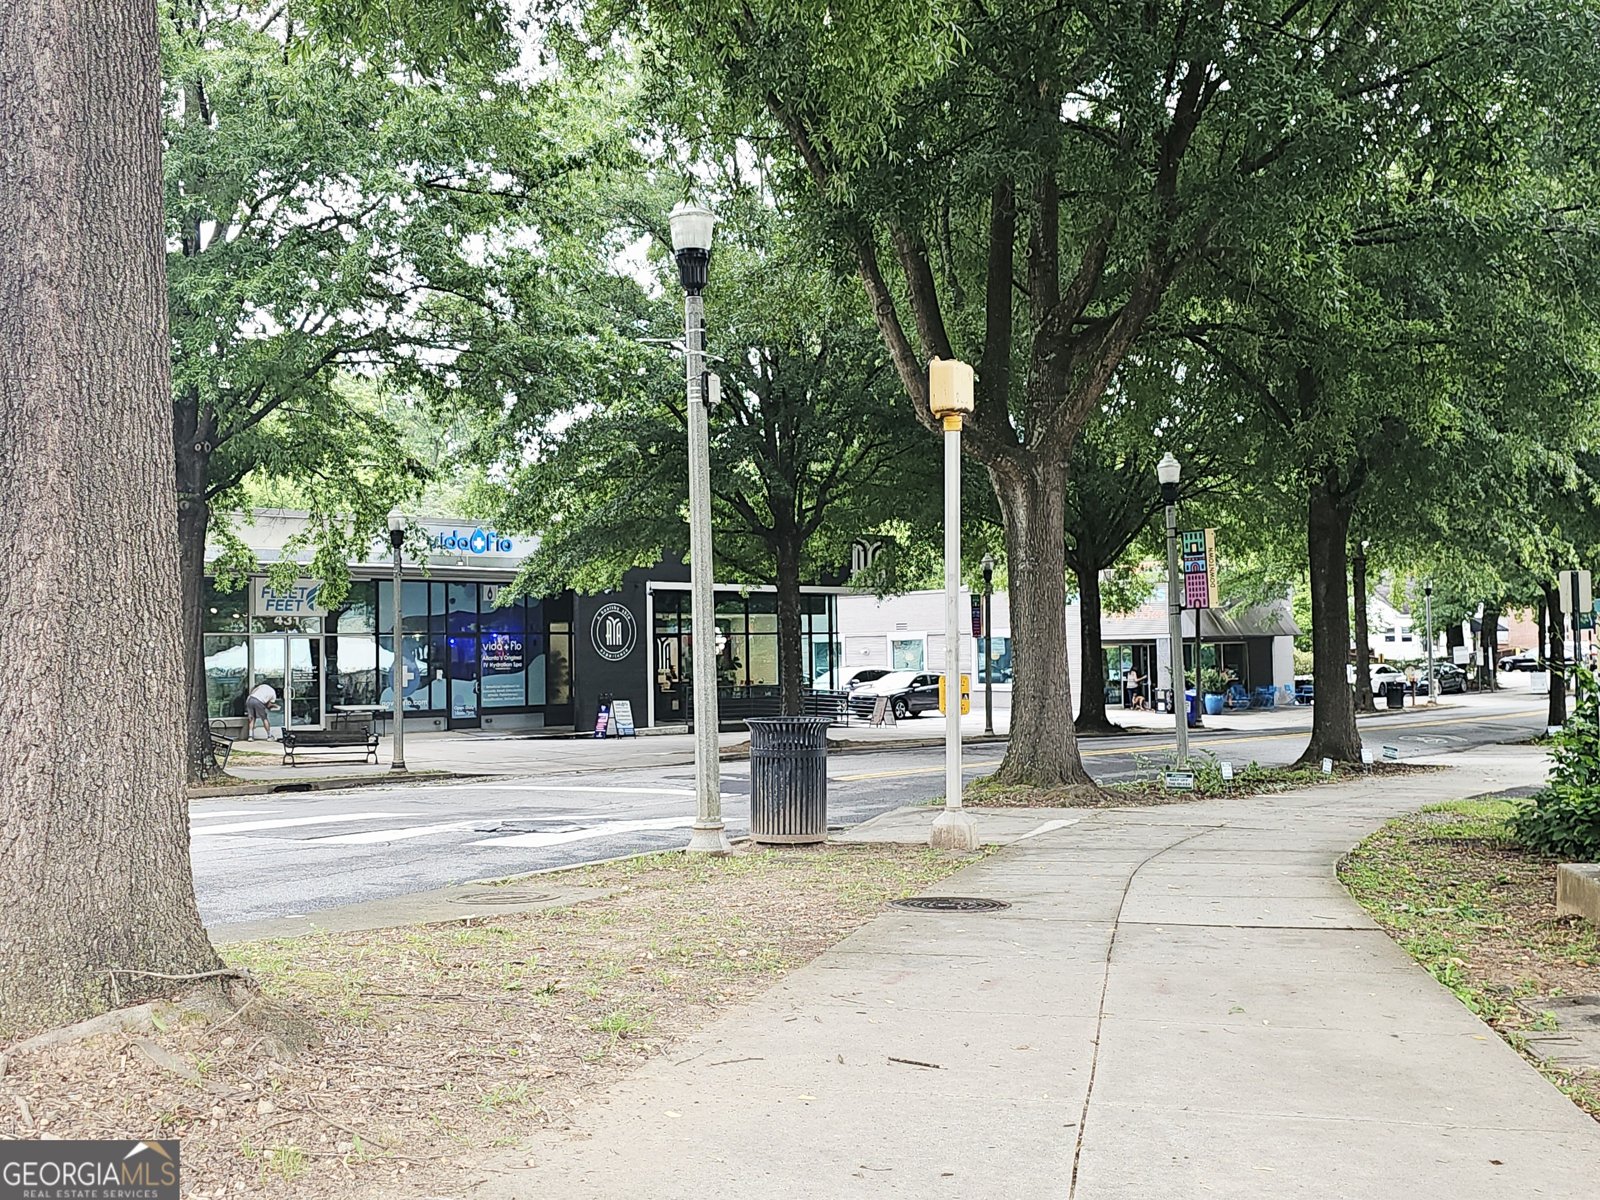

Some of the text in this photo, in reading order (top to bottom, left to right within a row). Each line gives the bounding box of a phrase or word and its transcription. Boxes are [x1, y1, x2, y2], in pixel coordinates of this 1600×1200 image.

[1208, 547, 1216, 588] DOWNTOWN
[265, 599, 304, 612] FEET
[274, 616, 300, 626] 431
